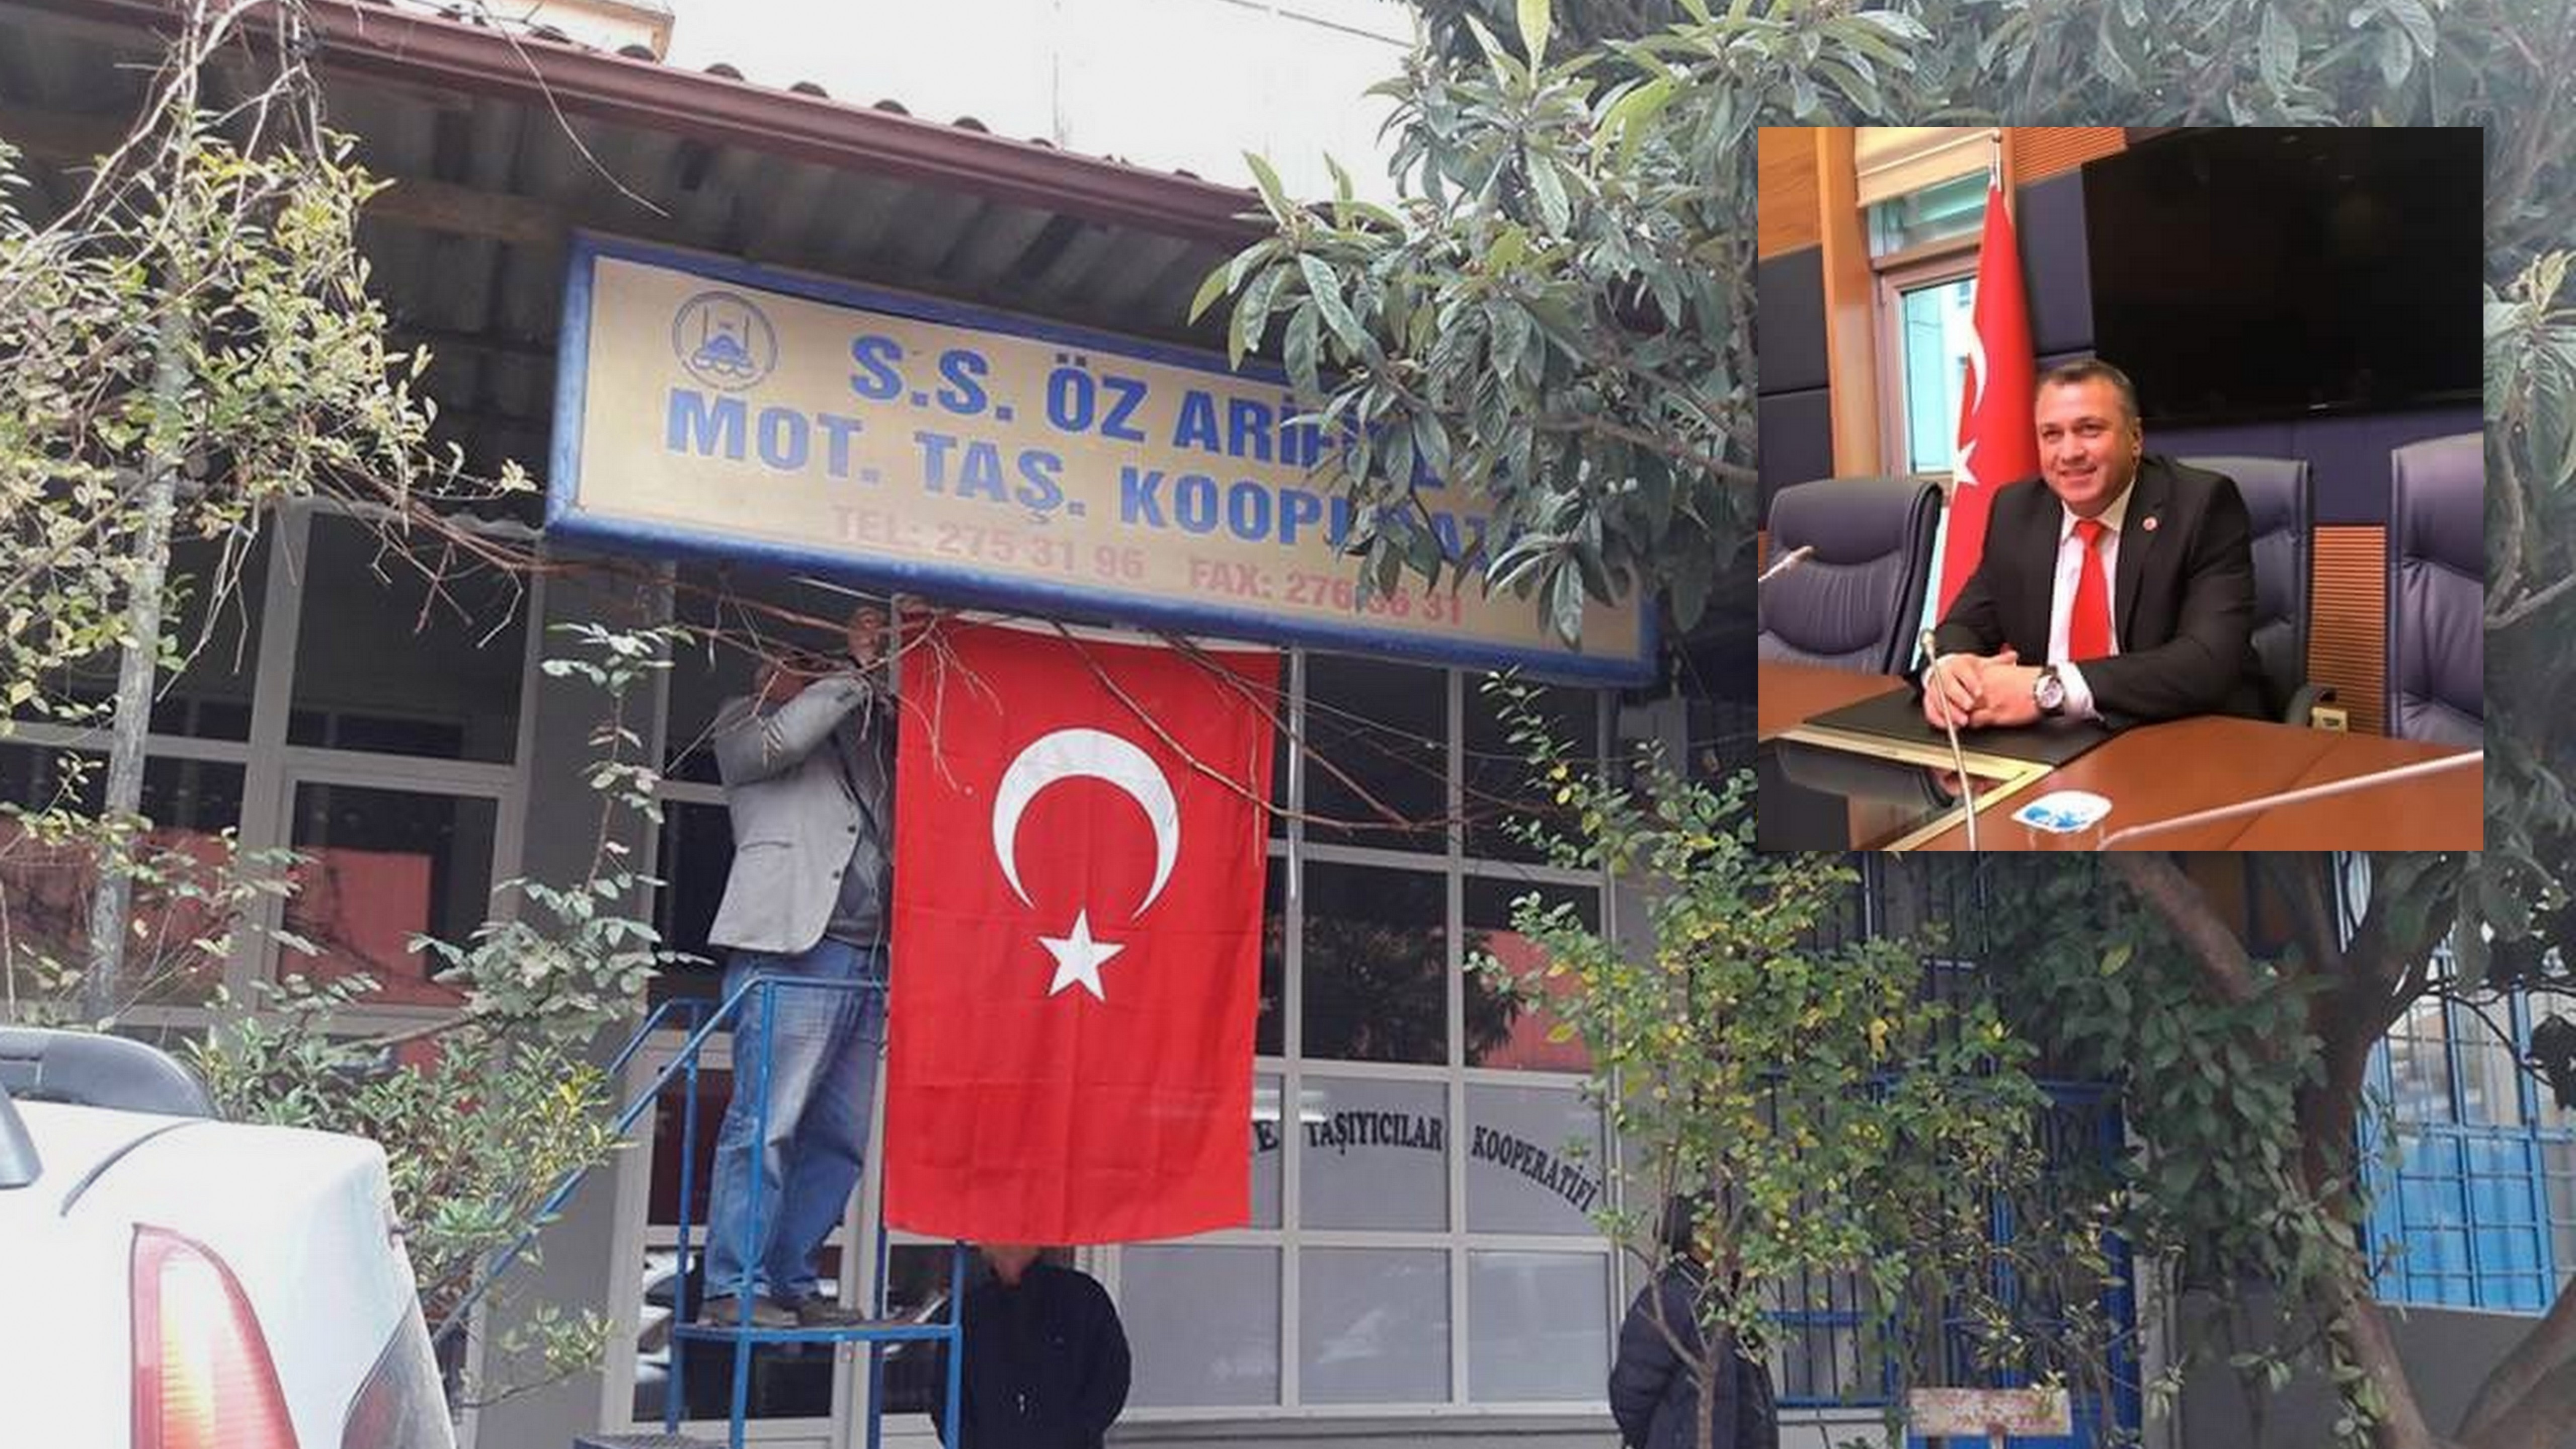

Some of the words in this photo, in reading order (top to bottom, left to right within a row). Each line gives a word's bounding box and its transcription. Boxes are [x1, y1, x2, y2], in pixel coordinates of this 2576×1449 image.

[850, 334, 1013, 422] S.S.
[1047, 352, 1149, 443] ÖZ
[667, 388, 880, 484] MOT.
[914, 431, 1086, 524] TAŞ.
[936, 520, 1014, 562] 275
[1031, 536, 1076, 572] 31
[1094, 544, 1145, 580] 96
[1189, 560, 1272, 599] FAX:
[1284, 569, 1353, 610] 276
[1423, 590, 1463, 626] 31
[1304, 1111, 1443, 1155] TAŞIYICILAR
[1471, 1125, 1602, 1213] KOOPERATİFİ
